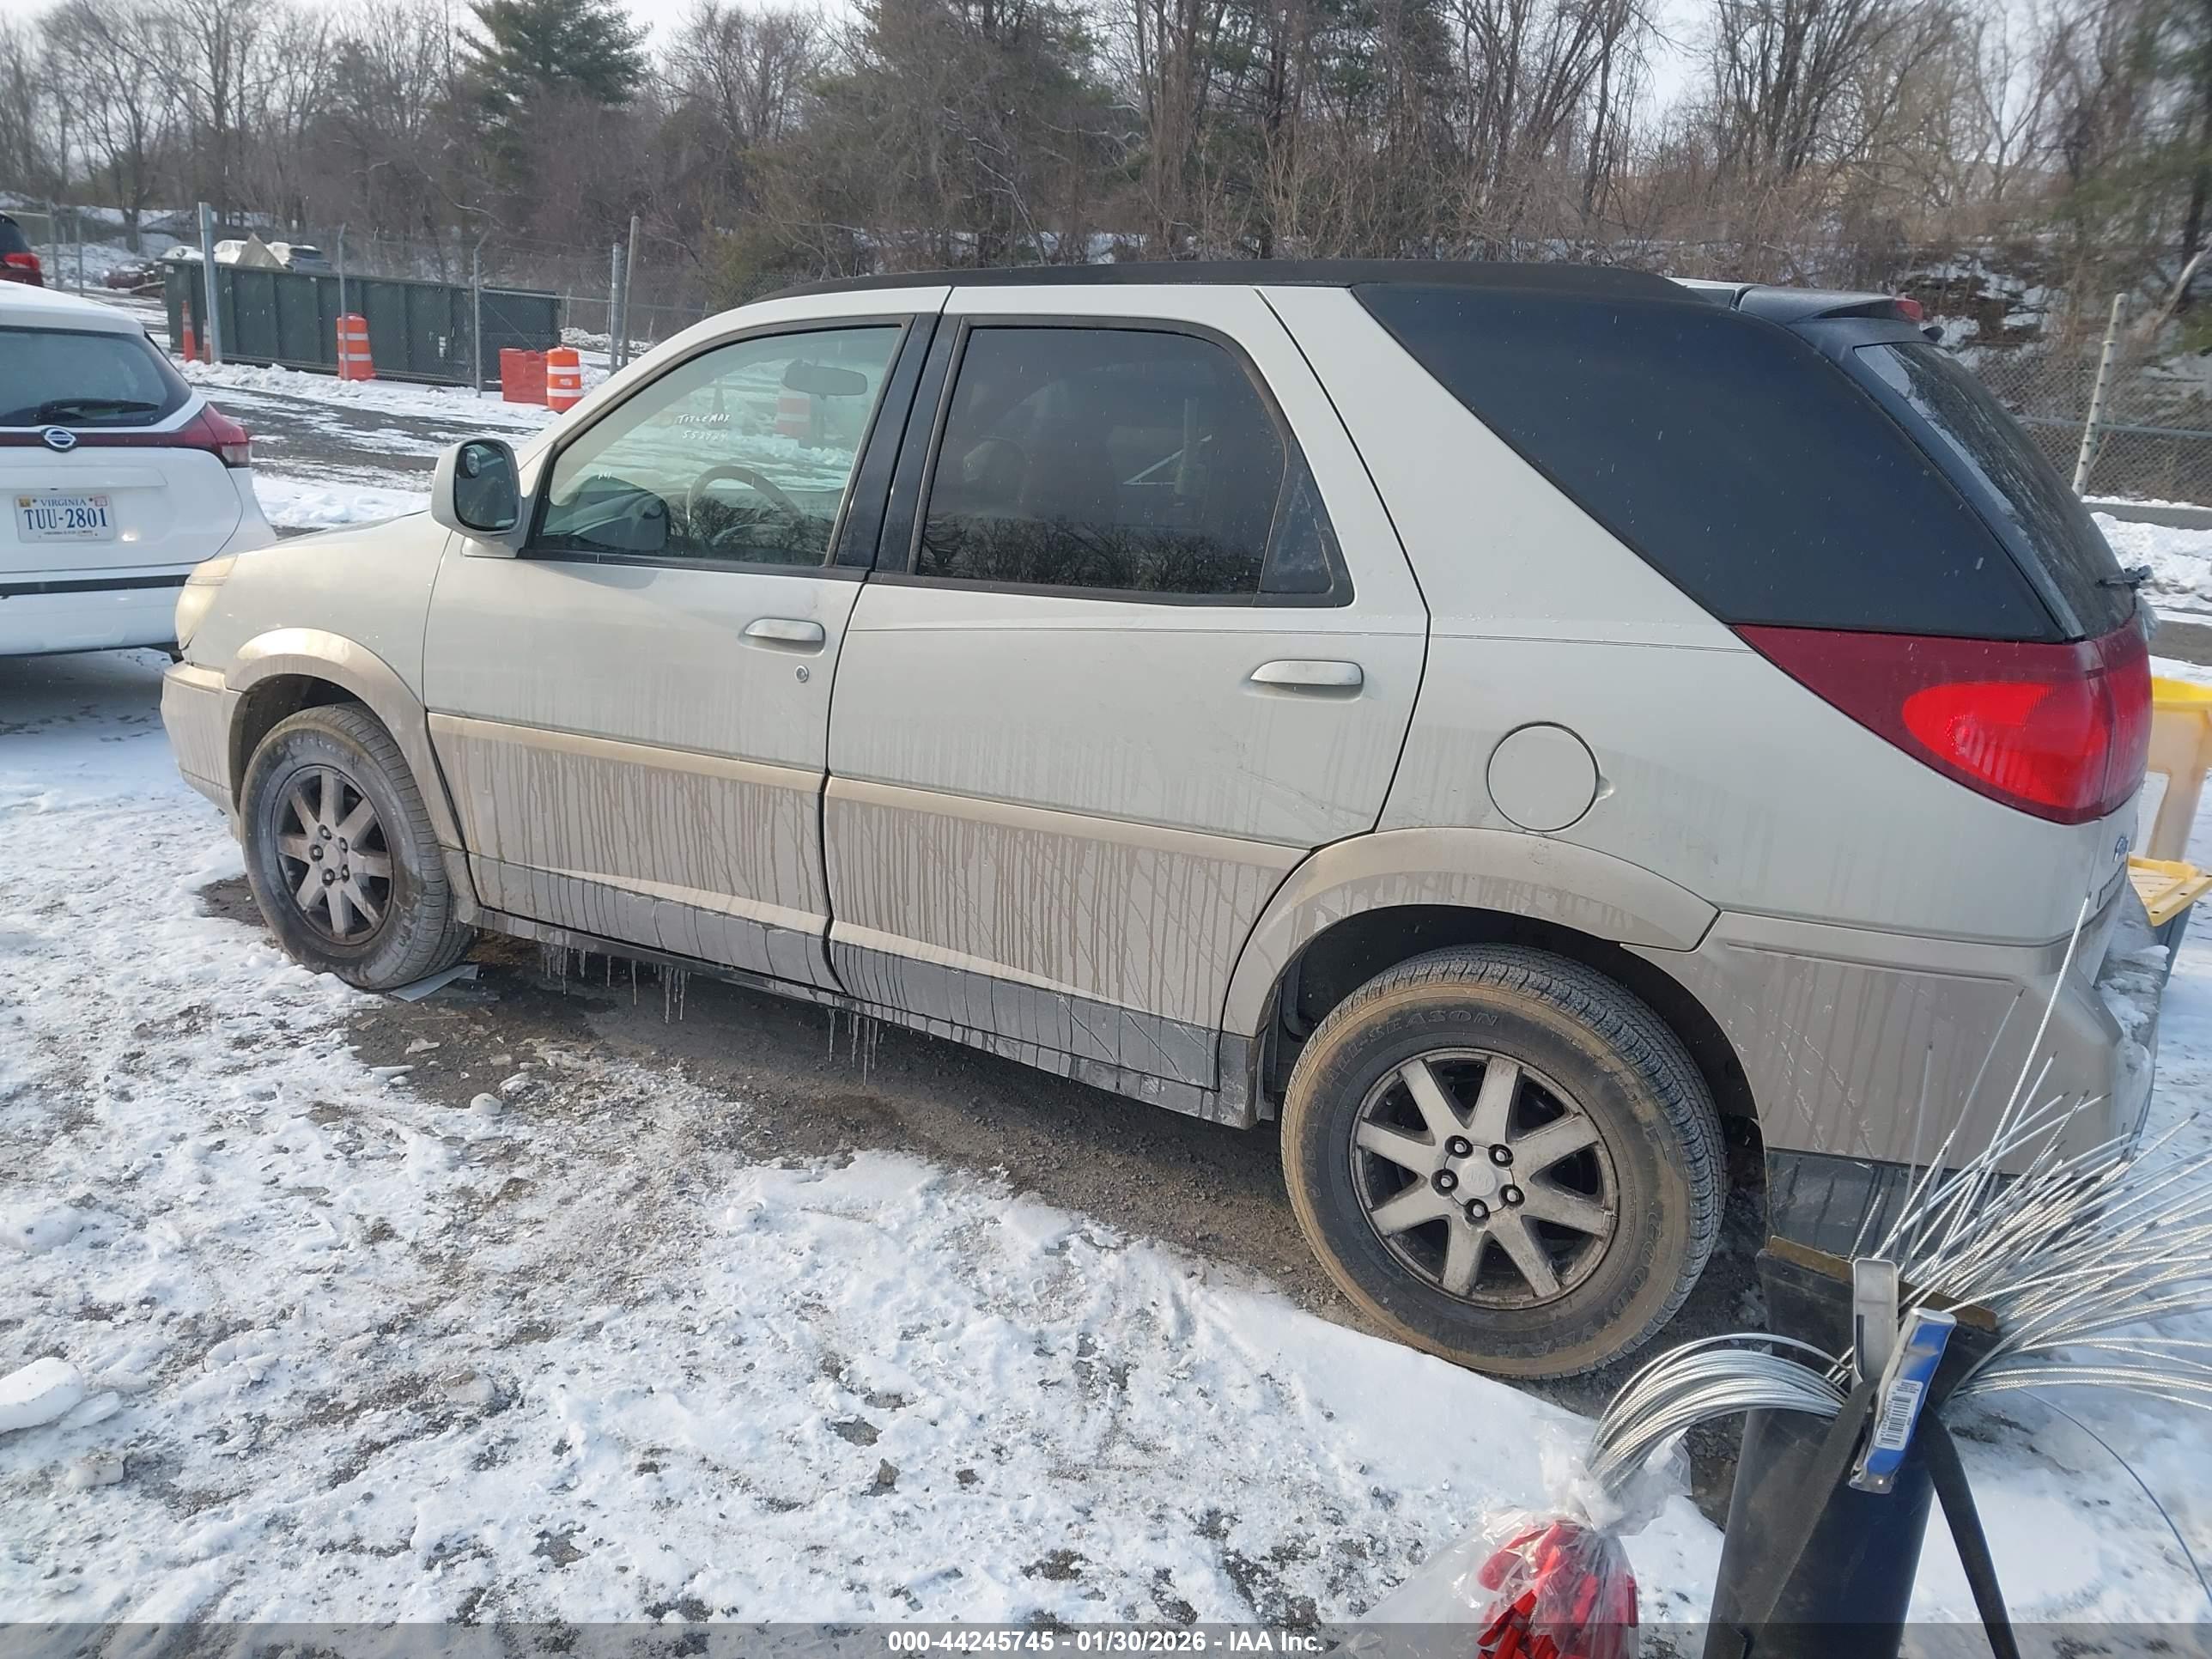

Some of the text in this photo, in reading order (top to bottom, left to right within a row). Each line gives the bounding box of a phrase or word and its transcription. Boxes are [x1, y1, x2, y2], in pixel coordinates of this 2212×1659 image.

[41, 498, 87, 507] VIRGINIA
[23, 507, 108, 531] TUU-2801
[1324, 1010, 1499, 1091] ALL-SEASON
